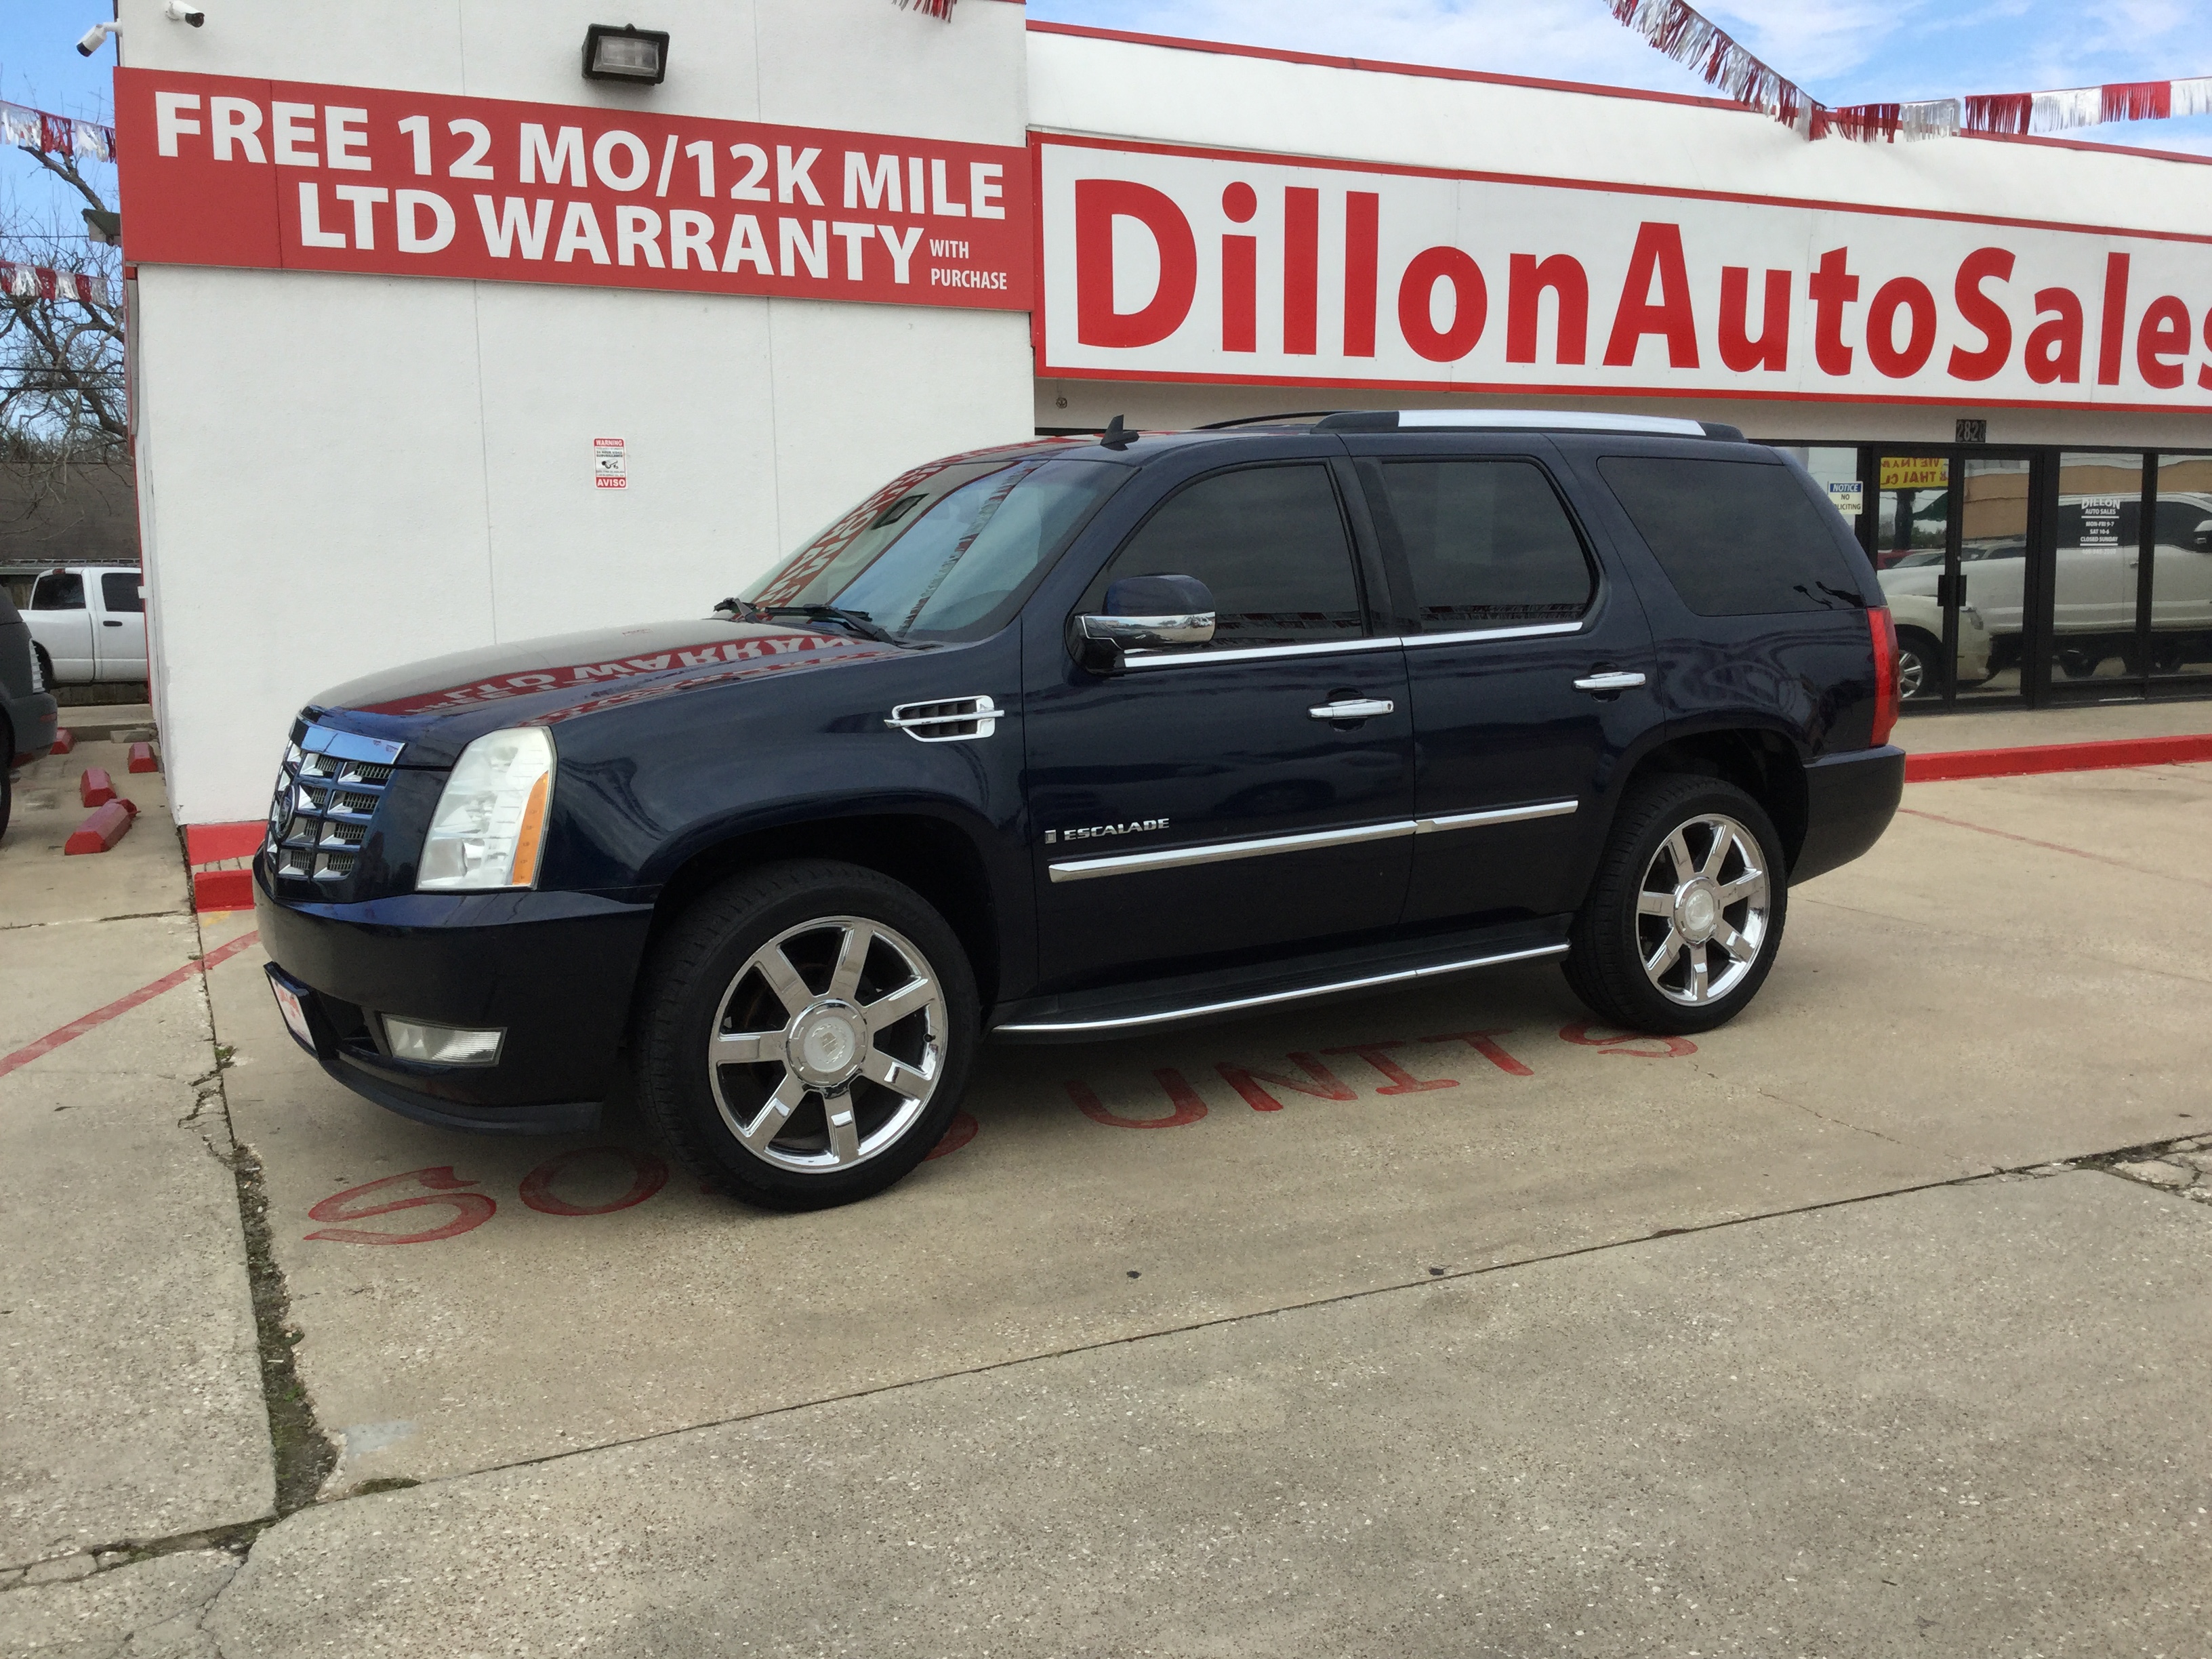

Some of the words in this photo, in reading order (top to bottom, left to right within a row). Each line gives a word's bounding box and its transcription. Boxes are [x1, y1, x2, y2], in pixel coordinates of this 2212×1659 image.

[155, 90, 372, 171] FREE
[397, 115, 494, 181] 12
[519, 122, 825, 207] MO/12K
[842, 150, 1006, 220] MILE
[298, 182, 457, 254] LTD
[473, 194, 925, 285] WARRANTY
[929, 238, 970, 260] WITH
[930, 268, 1008, 291] PURCHASE
[597, 478, 626, 487] AVISO
[1832, 484, 1858, 492] NOTICE
[2081, 498, 2121, 510] DILLON
[1064, 818, 1170, 841] ESCALADE
